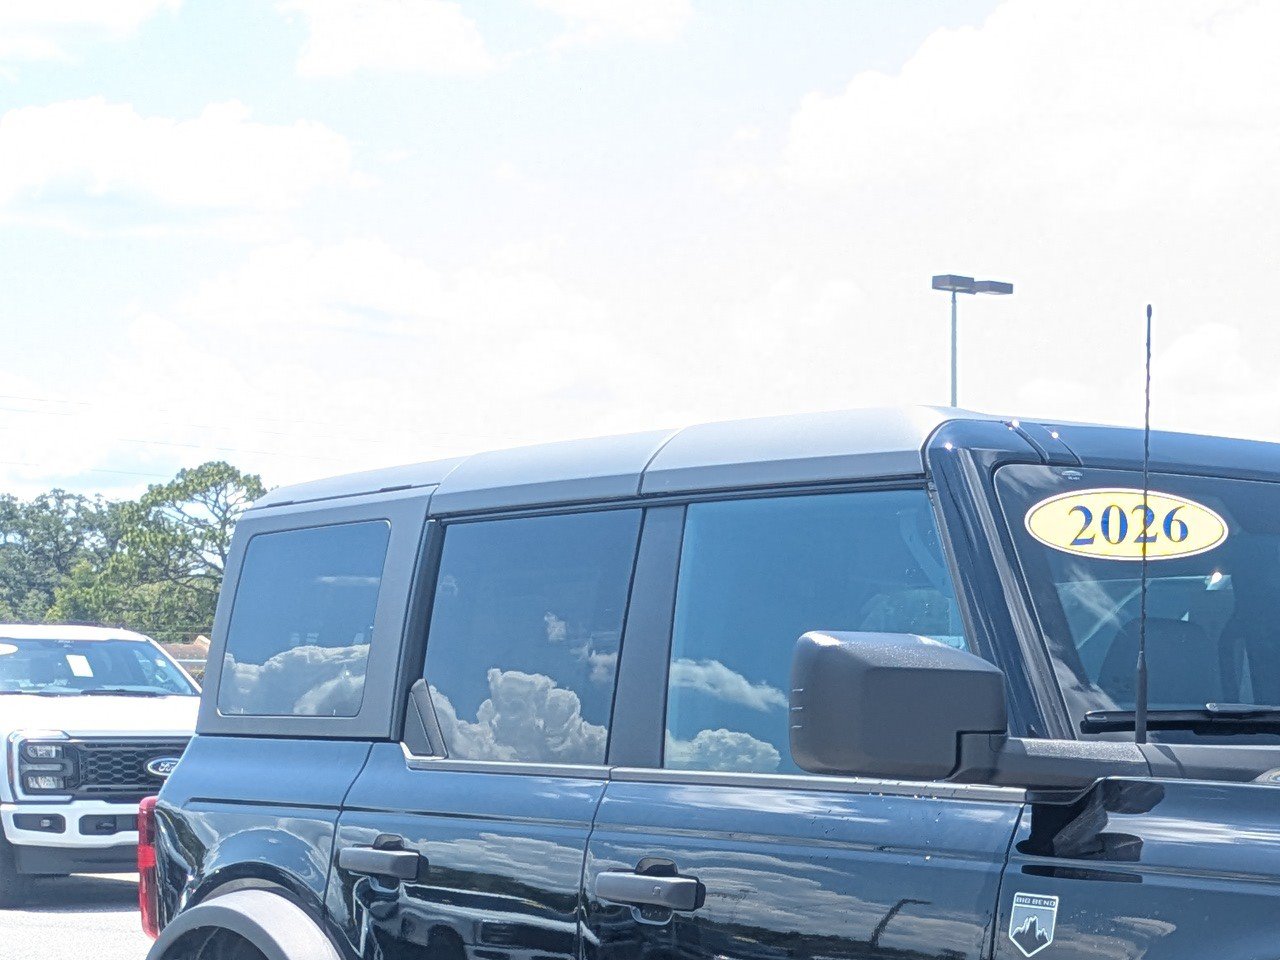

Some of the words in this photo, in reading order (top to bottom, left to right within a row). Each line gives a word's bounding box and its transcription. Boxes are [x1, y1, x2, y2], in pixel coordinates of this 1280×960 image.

[1068, 505, 1189, 546] 2026
[1016, 896, 1031, 904] BIG
[1032, 899, 1056, 907] BEND
